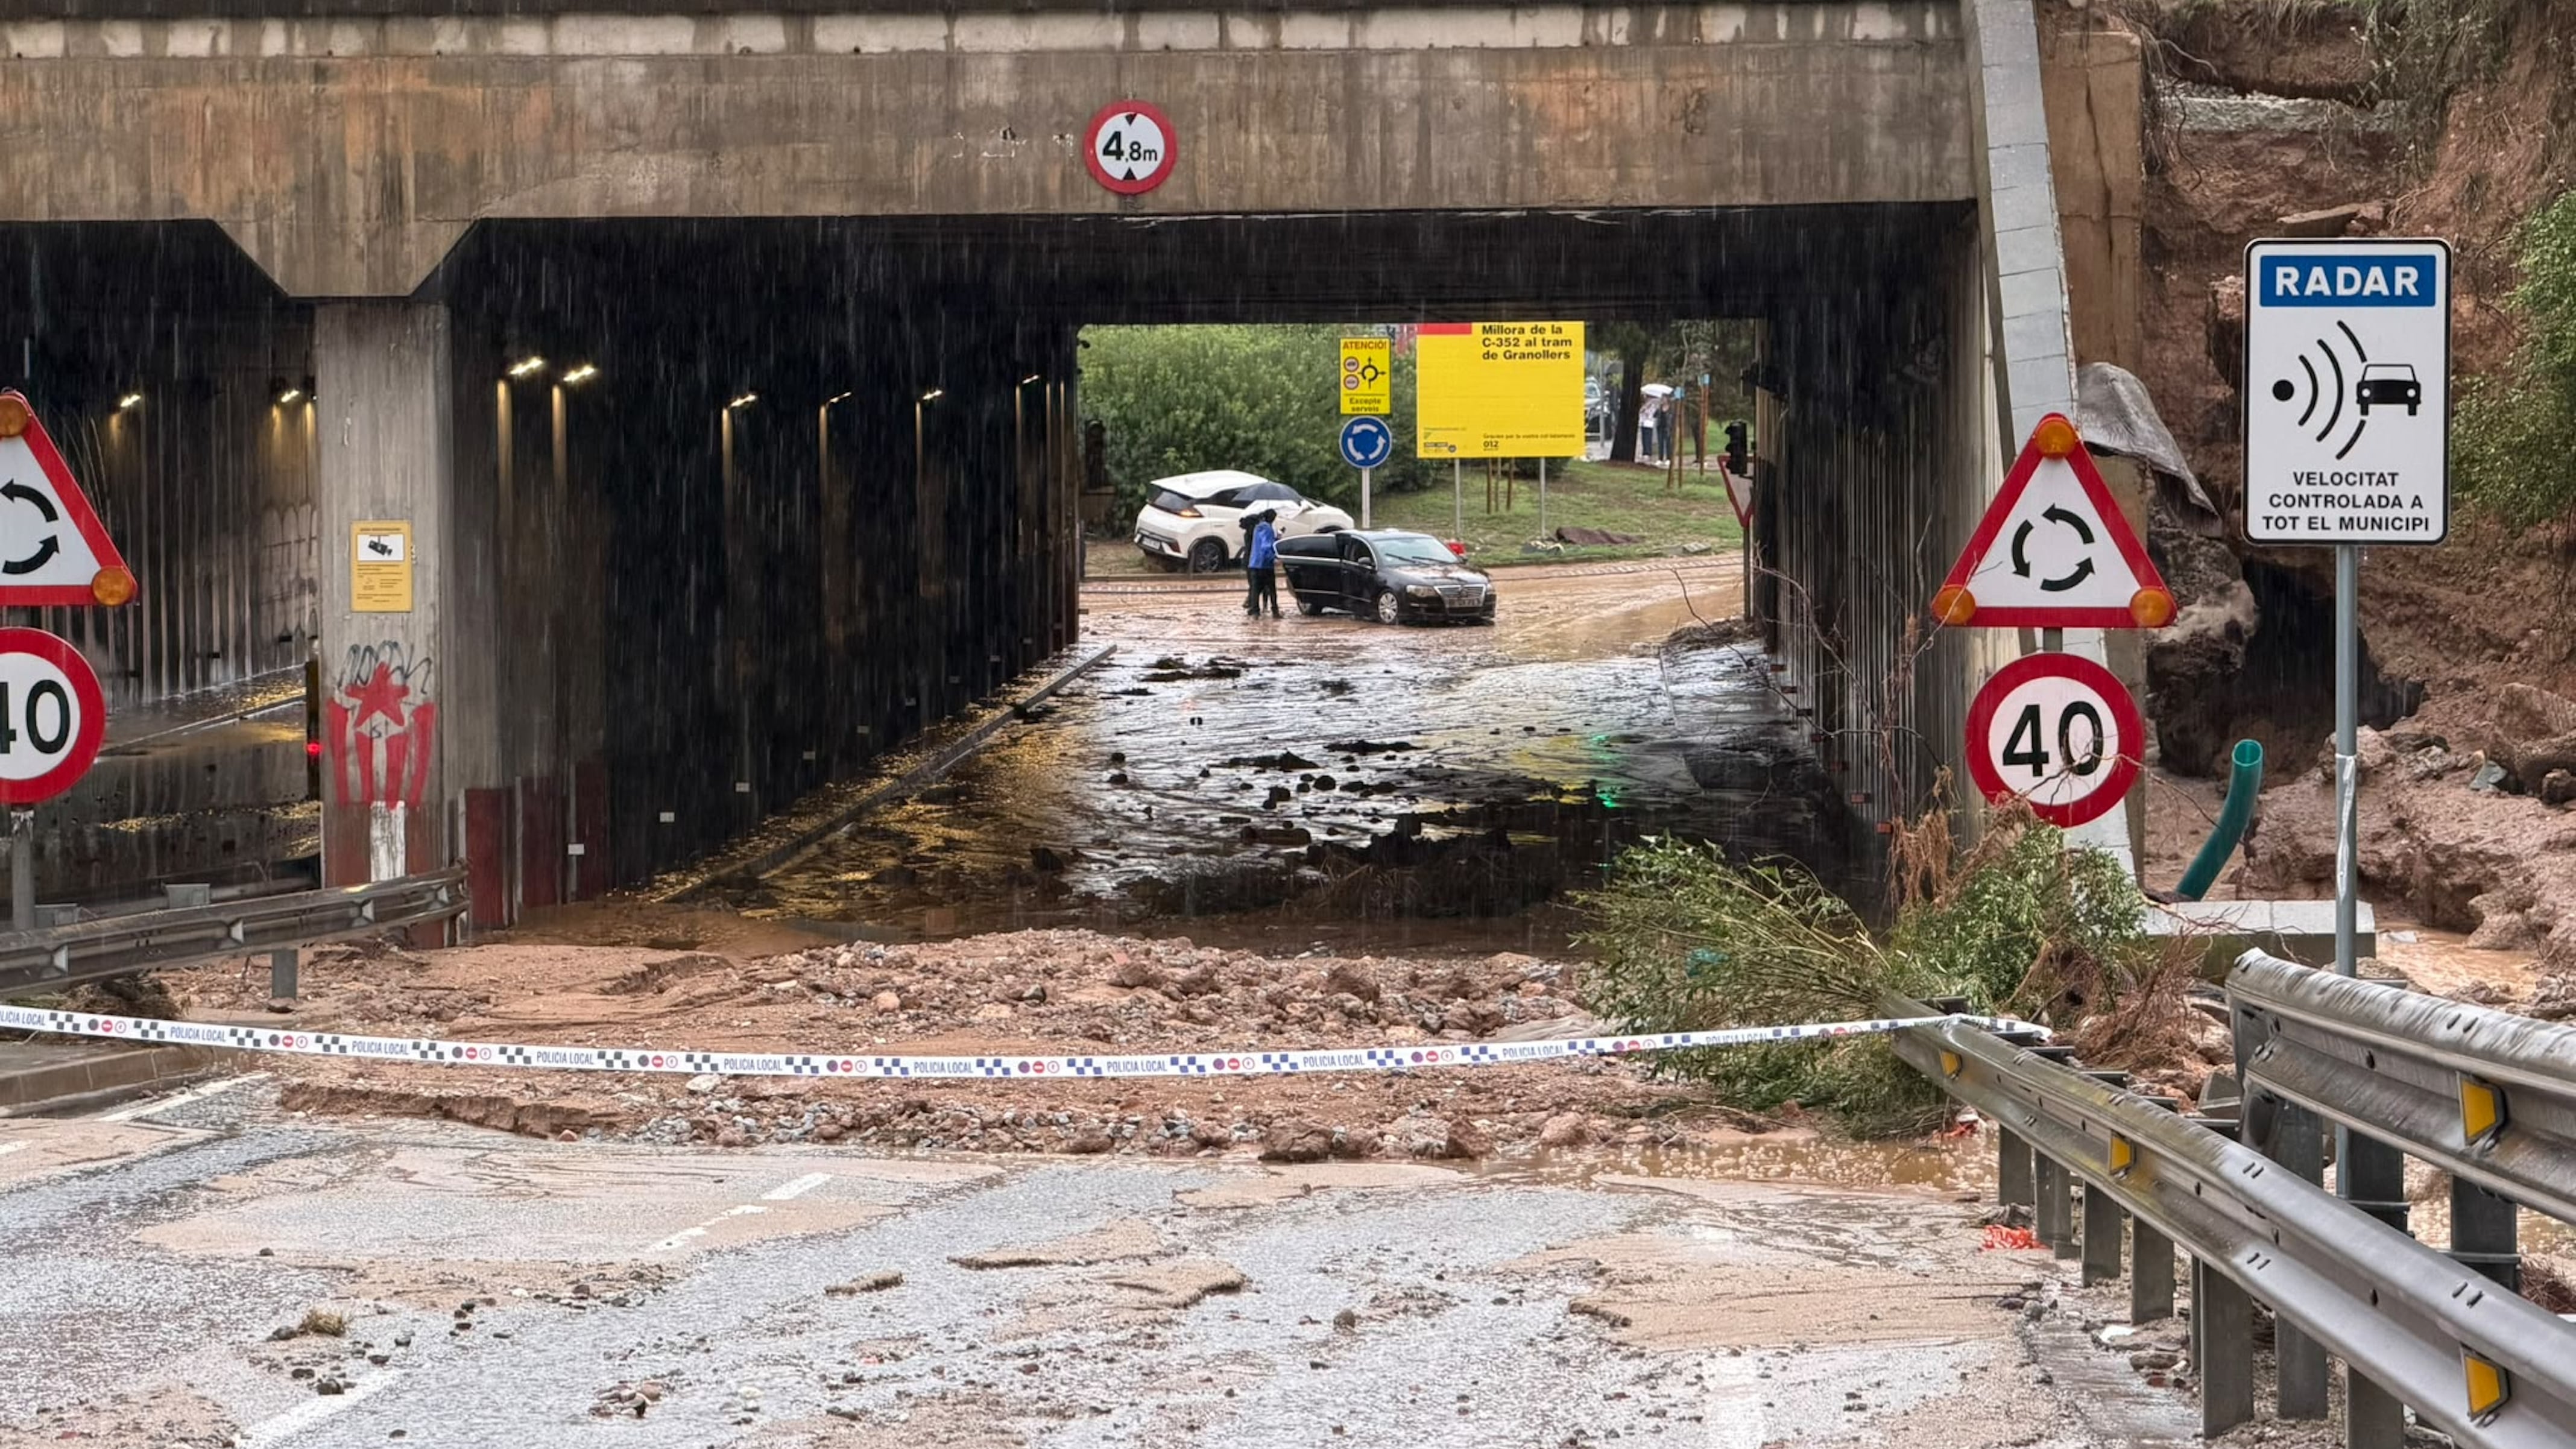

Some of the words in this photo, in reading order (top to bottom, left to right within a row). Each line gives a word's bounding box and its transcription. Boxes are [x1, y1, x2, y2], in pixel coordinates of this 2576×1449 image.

[1102, 131, 1158, 162] 4,8m
[2275, 266, 2419, 296] RADAR
[1482, 324, 1525, 335] Millora
[1530, 324, 1547, 335] de
[1552, 324, 1563, 334] la
[1482, 337, 1520, 347] C-352
[1525, 337, 1536, 347] al
[1542, 337, 1573, 347] tram
[1482, 350, 1498, 360] de
[1503, 350, 1571, 360] Granollers
[2293, 472, 2399, 487] VELOCITAT
[2268, 494, 2403, 509] CONTROLADA
[2411, 494, 2424, 509] A
[2262, 516, 2300, 531] TOT
[2308, 517, 2331, 531] EL
[2339, 516, 2429, 532] MUNICIPI
[2002, 700, 2104, 777] 40
[22, 1013, 45, 1026] LOCAL
[170, 1026, 200, 1040] POLICIA
[202, 1029, 226, 1042] LOCAL
[352, 1040, 382, 1053] POLICIA
[384, 1043, 409, 1055] LOCAL
[1502, 1046, 1536, 1058] POLICIA
[537, 1051, 567, 1064] POLICIA
[569, 1052, 594, 1065] LOCAL
[724, 1058, 754, 1070] POLICIA
[757, 1059, 783, 1071] LOCAL
[1303, 1055, 1336, 1067] POLICIA
[1338, 1054, 1365, 1066] LOCAL
[914, 1061, 945, 1073] POLICIA
[947, 1061, 974, 1073] LOCAL
[1106, 1060, 1139, 1073] POLICIA
[1141, 1059, 1167, 1072] LOCAL
